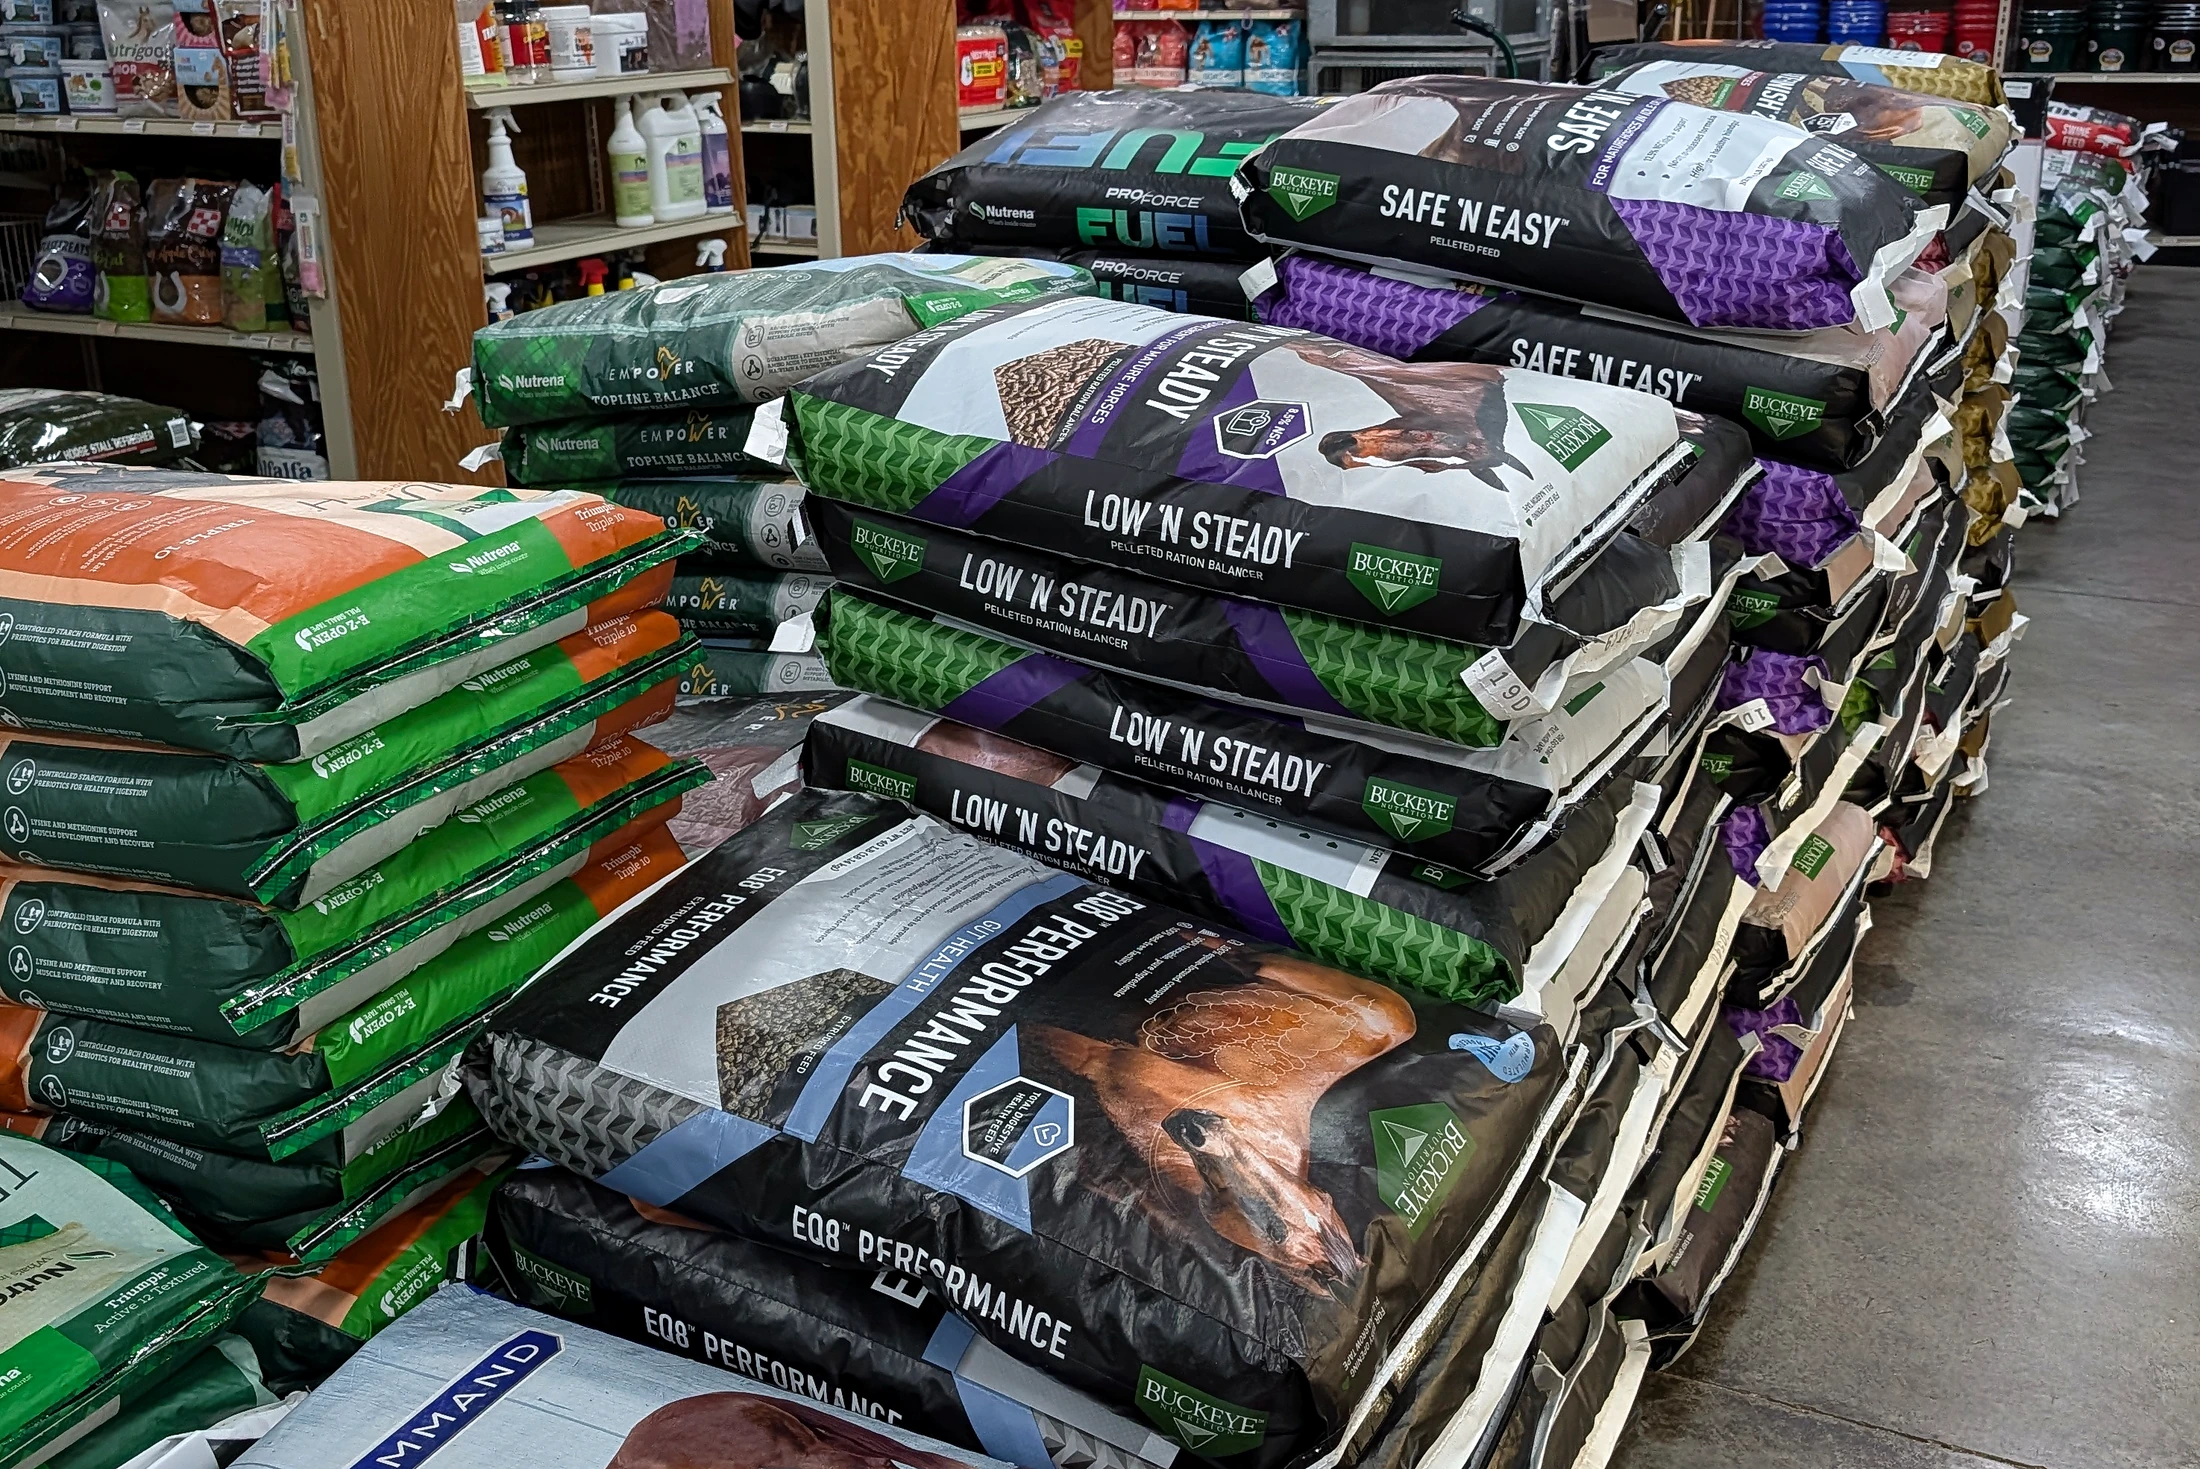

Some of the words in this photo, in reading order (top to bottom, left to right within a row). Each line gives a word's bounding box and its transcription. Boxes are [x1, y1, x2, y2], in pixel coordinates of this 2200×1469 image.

[1547, 90, 1623, 154] SAFE
[2062, 124, 2092, 138] SWINE
[2062, 136, 2086, 148] FEED
[1273, 172, 1334, 196] BUCKEYE
[1592, 165, 1610, 186] FOR
[1889, 171, 1930, 188] CKEYE
[985, 204, 1035, 221] Nutrena
[1380, 184, 1451, 227] SAFE
[1485, 204, 1561, 249] EASY
[1077, 207, 1211, 254] FUEL
[1430, 235, 1475, 254] PELLETED
[1476, 245, 1500, 258] FEED
[609, 346, 694, 382] EMPOWER
[1095, 358, 1123, 384] PELLETED
[1122, 350, 1161, 383] MATURE
[1510, 338, 1582, 378] SAFE
[1618, 361, 1694, 401] EASY
[515, 373, 565, 390] Nutrena
[1145, 338, 1256, 422] STEADY
[592, 391, 647, 407] TOPLINE
[649, 383, 718, 405] BALANCE
[1079, 382, 1101, 408] RATION
[1092, 382, 1130, 424] HORSES
[1748, 394, 1820, 420] BUCKEYE
[1057, 403, 1083, 443] BALANCER
[1280, 406, 1302, 431] 8.5%
[90, 440, 112, 455] STALL
[550, 437, 599, 452] Nutrena
[1264, 424, 1287, 447] NSC
[1546, 413, 1602, 463] BUCKEYE
[627, 453, 685, 468] TOPLINE
[186, 519, 256, 546] TRIPLE
[586, 513, 615, 533] Triple
[614, 512, 625, 524] 10
[1084, 490, 1152, 535] LOW
[1190, 510, 1303, 568] STEADY
[154, 543, 181, 560] 10
[468, 541, 520, 567] Nutrena
[854, 526, 920, 563] BUCKEYE
[1110, 541, 1163, 558] PELLETED
[1165, 550, 1205, 570] RATION
[1207, 560, 1264, 581] BALANCER
[1353, 551, 1437, 588] BUCKEYE
[959, 553, 1023, 601] LOW
[1059, 581, 1169, 638] STEADY
[311, 624, 348, 648] OPEN
[344, 615, 372, 635] E-Z
[625, 623, 638, 635] 10
[984, 603, 1033, 622] PELLETED
[1035, 614, 1072, 634] RATION
[1073, 625, 1128, 650] BALANCER
[478, 659, 531, 686] Nutrena
[327, 749, 364, 774] OPEN
[1109, 706, 1171, 756] LOW
[1209, 736, 1325, 798] STEADY
[33, 779, 69, 791] PREBIOTICS
[70, 782, 82, 792] FOR
[83, 784, 115, 796] HEALTHY
[115, 787, 148, 797] DIGESTION
[38, 769, 78, 782] CONTROLLED
[79, 773, 103, 785] STARCH
[103, 775, 135, 787] FORMULA
[135, 778, 153, 788] WITH
[849, 766, 914, 799] BUCKEYE
[1135, 754, 1184, 777] PELLETED
[1186, 766, 1224, 788] RATION
[1226, 781, 1283, 807] BALANCER
[475, 786, 527, 817] Nutrena
[1369, 784, 1451, 821] BUCKEYE
[30, 818, 52, 829] LYSINE
[52, 821, 66, 830] AND
[67, 822, 106, 835] METHIONINE
[106, 827, 138, 837] SUPPORT
[32, 828, 56, 840] MUSCLE
[57, 831, 103, 845] DEVELOPMENT
[104, 835, 119, 846] AND
[119, 837, 155, 849] RECOVERY
[950, 790, 1007, 836] LOW
[1044, 820, 1148, 881] STEADY
[601, 843, 644, 872] Triumph
[614, 860, 642, 882] Triple
[639, 855, 651, 868] 10
[1026, 848, 1061, 869] RATION
[738, 867, 787, 893] EQ8
[327, 887, 364, 911] OPEN
[1073, 890, 1147, 923] EQ8
[503, 902, 554, 934] Nutrena
[652, 895, 706, 936] EXTRUDED
[625, 929, 654, 957] FEED
[962, 920, 1002, 950] GUT
[588, 892, 747, 1010] PERFORMANCE
[1114, 948, 1142, 966] facility
[1149, 958, 1164, 971] pure
[905, 942, 972, 994] HEALTH
[1113, 967, 1153, 998] ingredients
[1144, 980, 1175, 1005] company
[393, 997, 417, 1018] E-Z
[858, 914, 1098, 1122] PERFORMANCE
[362, 1010, 396, 1039] OPEN
[811, 1014, 852, 1053] EXTRUDED
[796, 1046, 818, 1075] FEED
[1503, 1036, 1531, 1076] FORMULATED
[1509, 1042, 1520, 1058] WITH
[1000, 1092, 1026, 1120] HEALTH
[1021, 1091, 1042, 1118] TOTAL
[984, 1119, 1003, 1143] FEED
[990, 1111, 1024, 1155] DIGESTIVE
[1395, 1119, 1468, 1224] BUCKEYE
[105, 1266, 169, 1311] Triumph
[514, 1248, 589, 1302] BUCKEYE
[791, 1204, 840, 1254] EQ8
[859, 1227, 1073, 1361] PERFORMANCE
[94, 1303, 137, 1334] Active
[138, 1290, 153, 1309] 12
[151, 1261, 209, 1302] Textured
[394, 1279, 422, 1309] OPEN
[644, 1306, 691, 1350] EQ8
[704, 1332, 904, 1425] PERFORMANCE
[376, 1342, 542, 1469] MMAND
[1144, 1378, 1258, 1436] BUCKEYE
